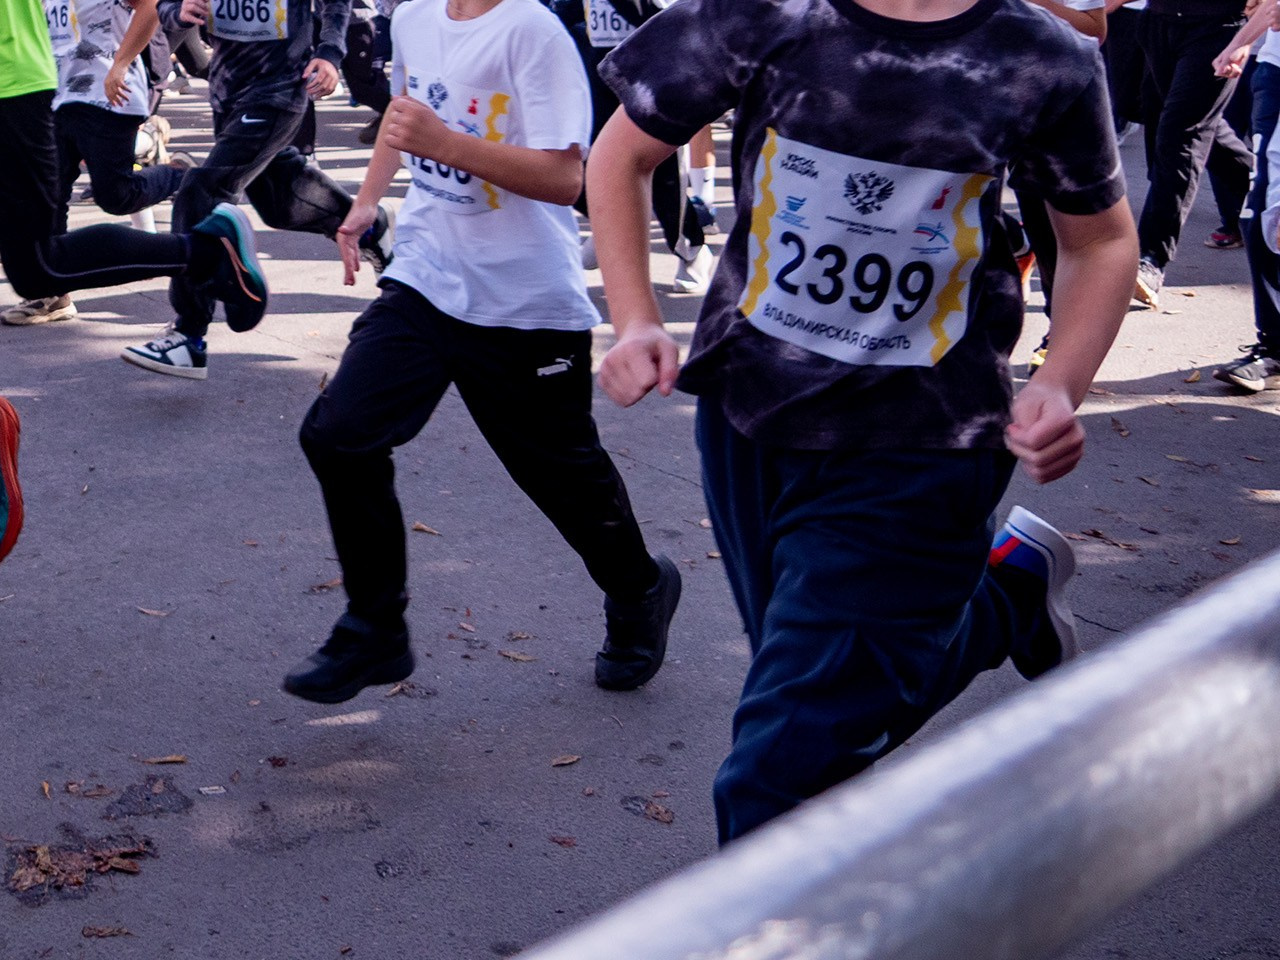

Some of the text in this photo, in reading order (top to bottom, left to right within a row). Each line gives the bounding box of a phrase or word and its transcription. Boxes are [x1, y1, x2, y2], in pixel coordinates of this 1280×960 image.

[45, 4, 69, 28] 16
[775, 231, 935, 322] 2399
[762, 302, 912, 351] ВЛАДИМИРСКАЯ ОБЛАСТЬ
